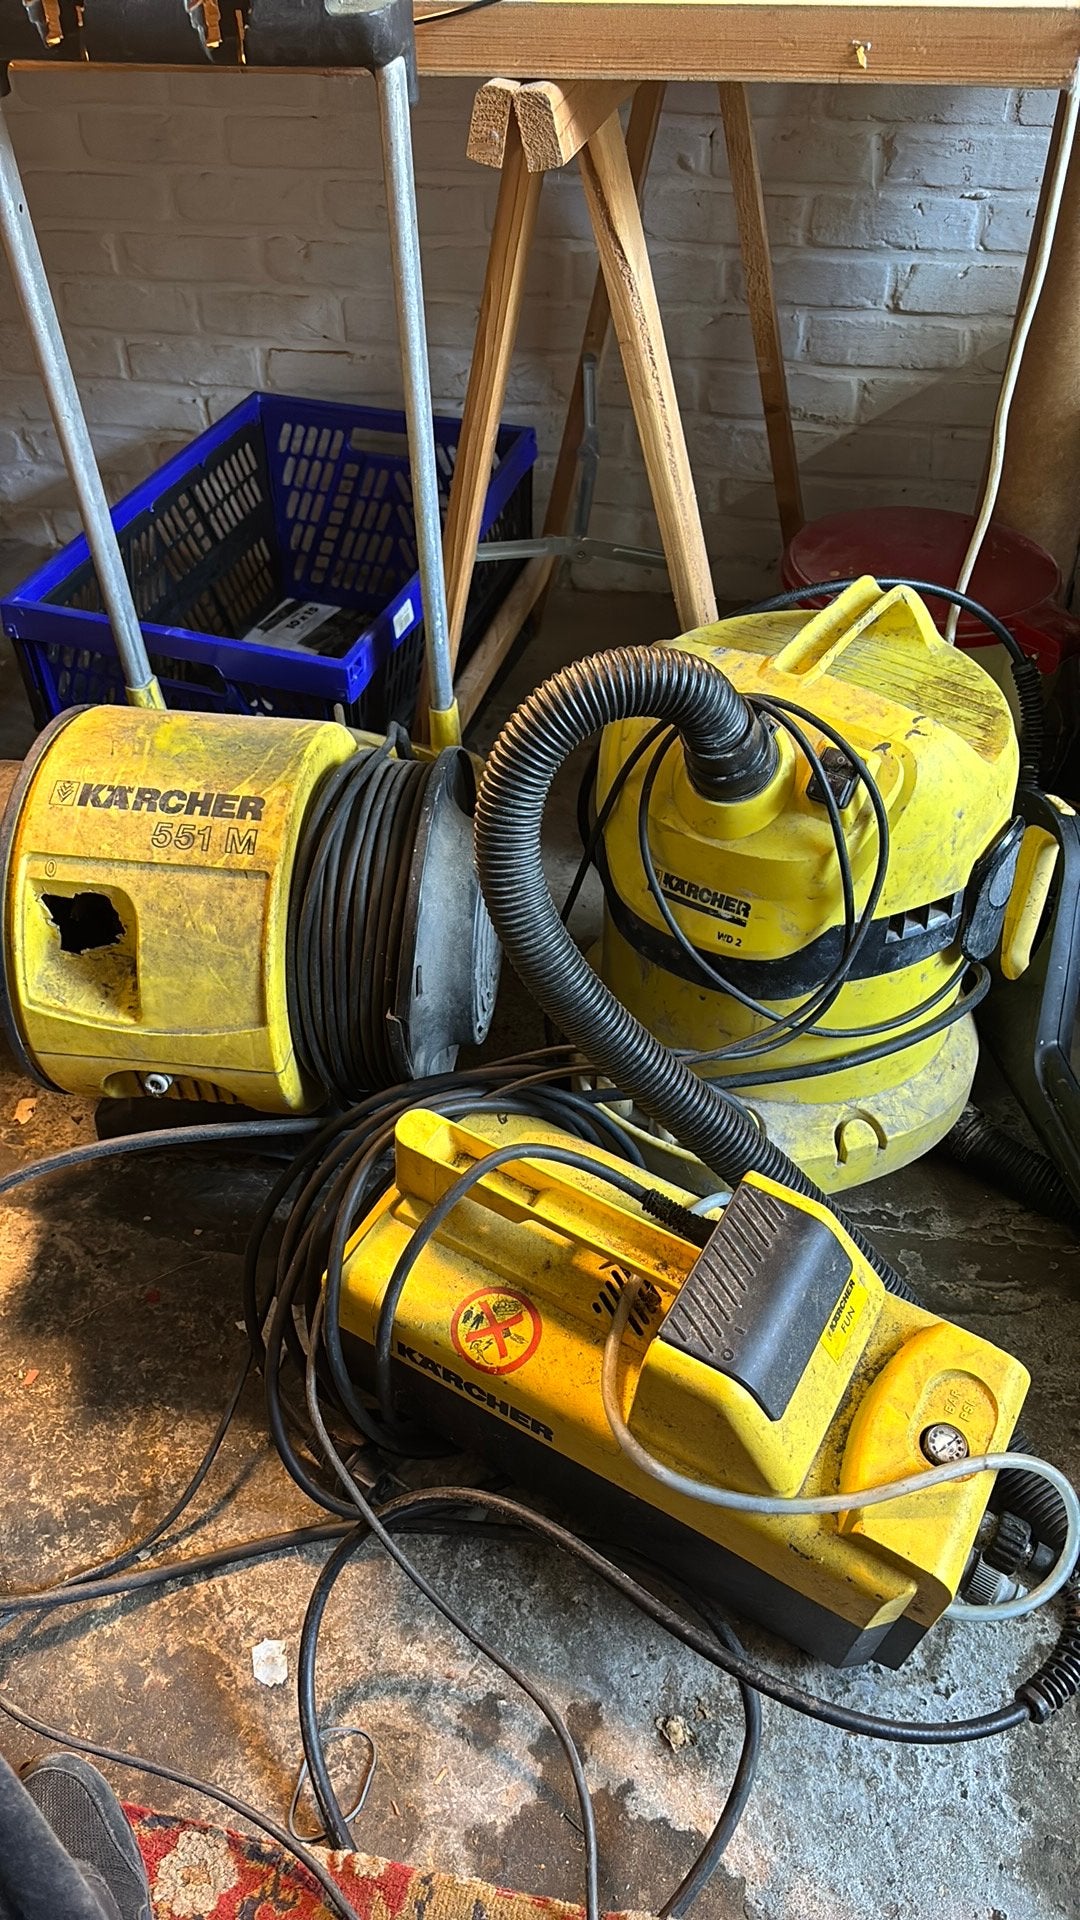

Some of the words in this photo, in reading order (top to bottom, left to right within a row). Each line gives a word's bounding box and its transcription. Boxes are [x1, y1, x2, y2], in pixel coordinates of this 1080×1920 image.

[77, 782, 266, 821] KÄRCHER
[151, 821, 213, 852] 551
[225, 826, 259, 856] M
[662, 871, 752, 919] KÄRCHER
[717, 931, 734, 945] WD
[735, 938, 742, 947] 2
[840, 1305, 856, 1334] FUN
[397, 1341, 555, 1442] KÄRCHER
[943, 1389, 961, 1415] BAR
[958, 1400, 976, 1423] PSI
